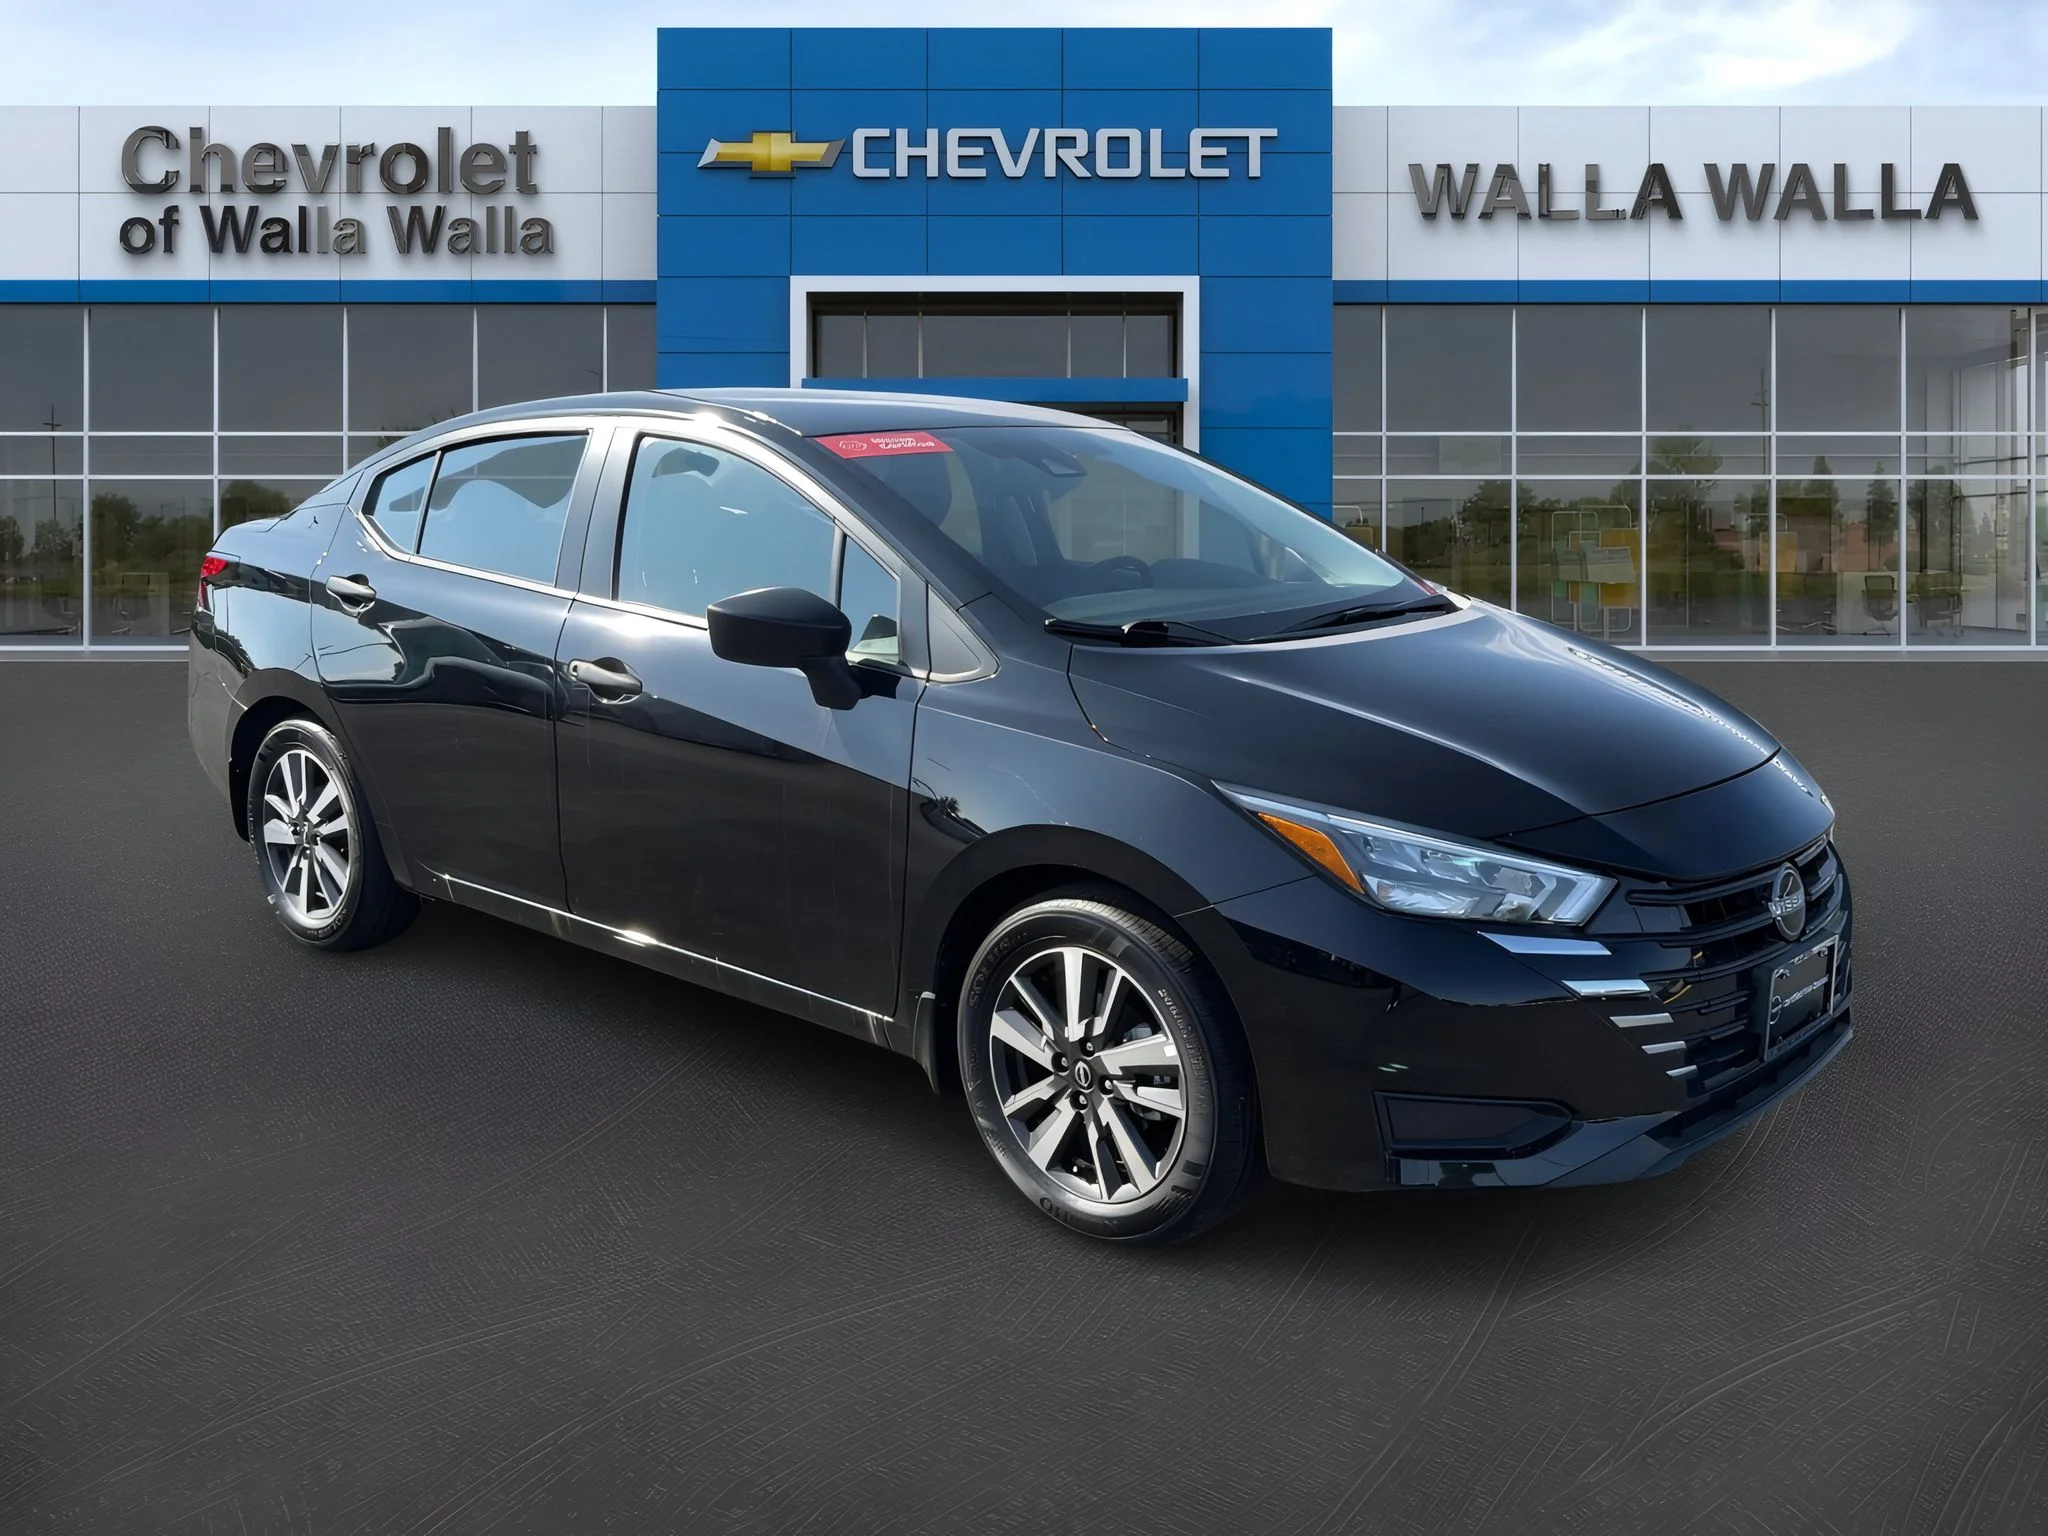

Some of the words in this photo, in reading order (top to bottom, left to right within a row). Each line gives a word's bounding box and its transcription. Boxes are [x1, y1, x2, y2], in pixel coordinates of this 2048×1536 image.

[121, 125, 538, 195] Chevrolet
[852, 127, 1278, 179] CHEVROLET
[1407, 162, 1684, 221] WALLA
[1702, 162, 1979, 221] WALLA
[119, 204, 180, 255] of
[199, 204, 367, 255] Walla
[385, 204, 556, 255] Walla
